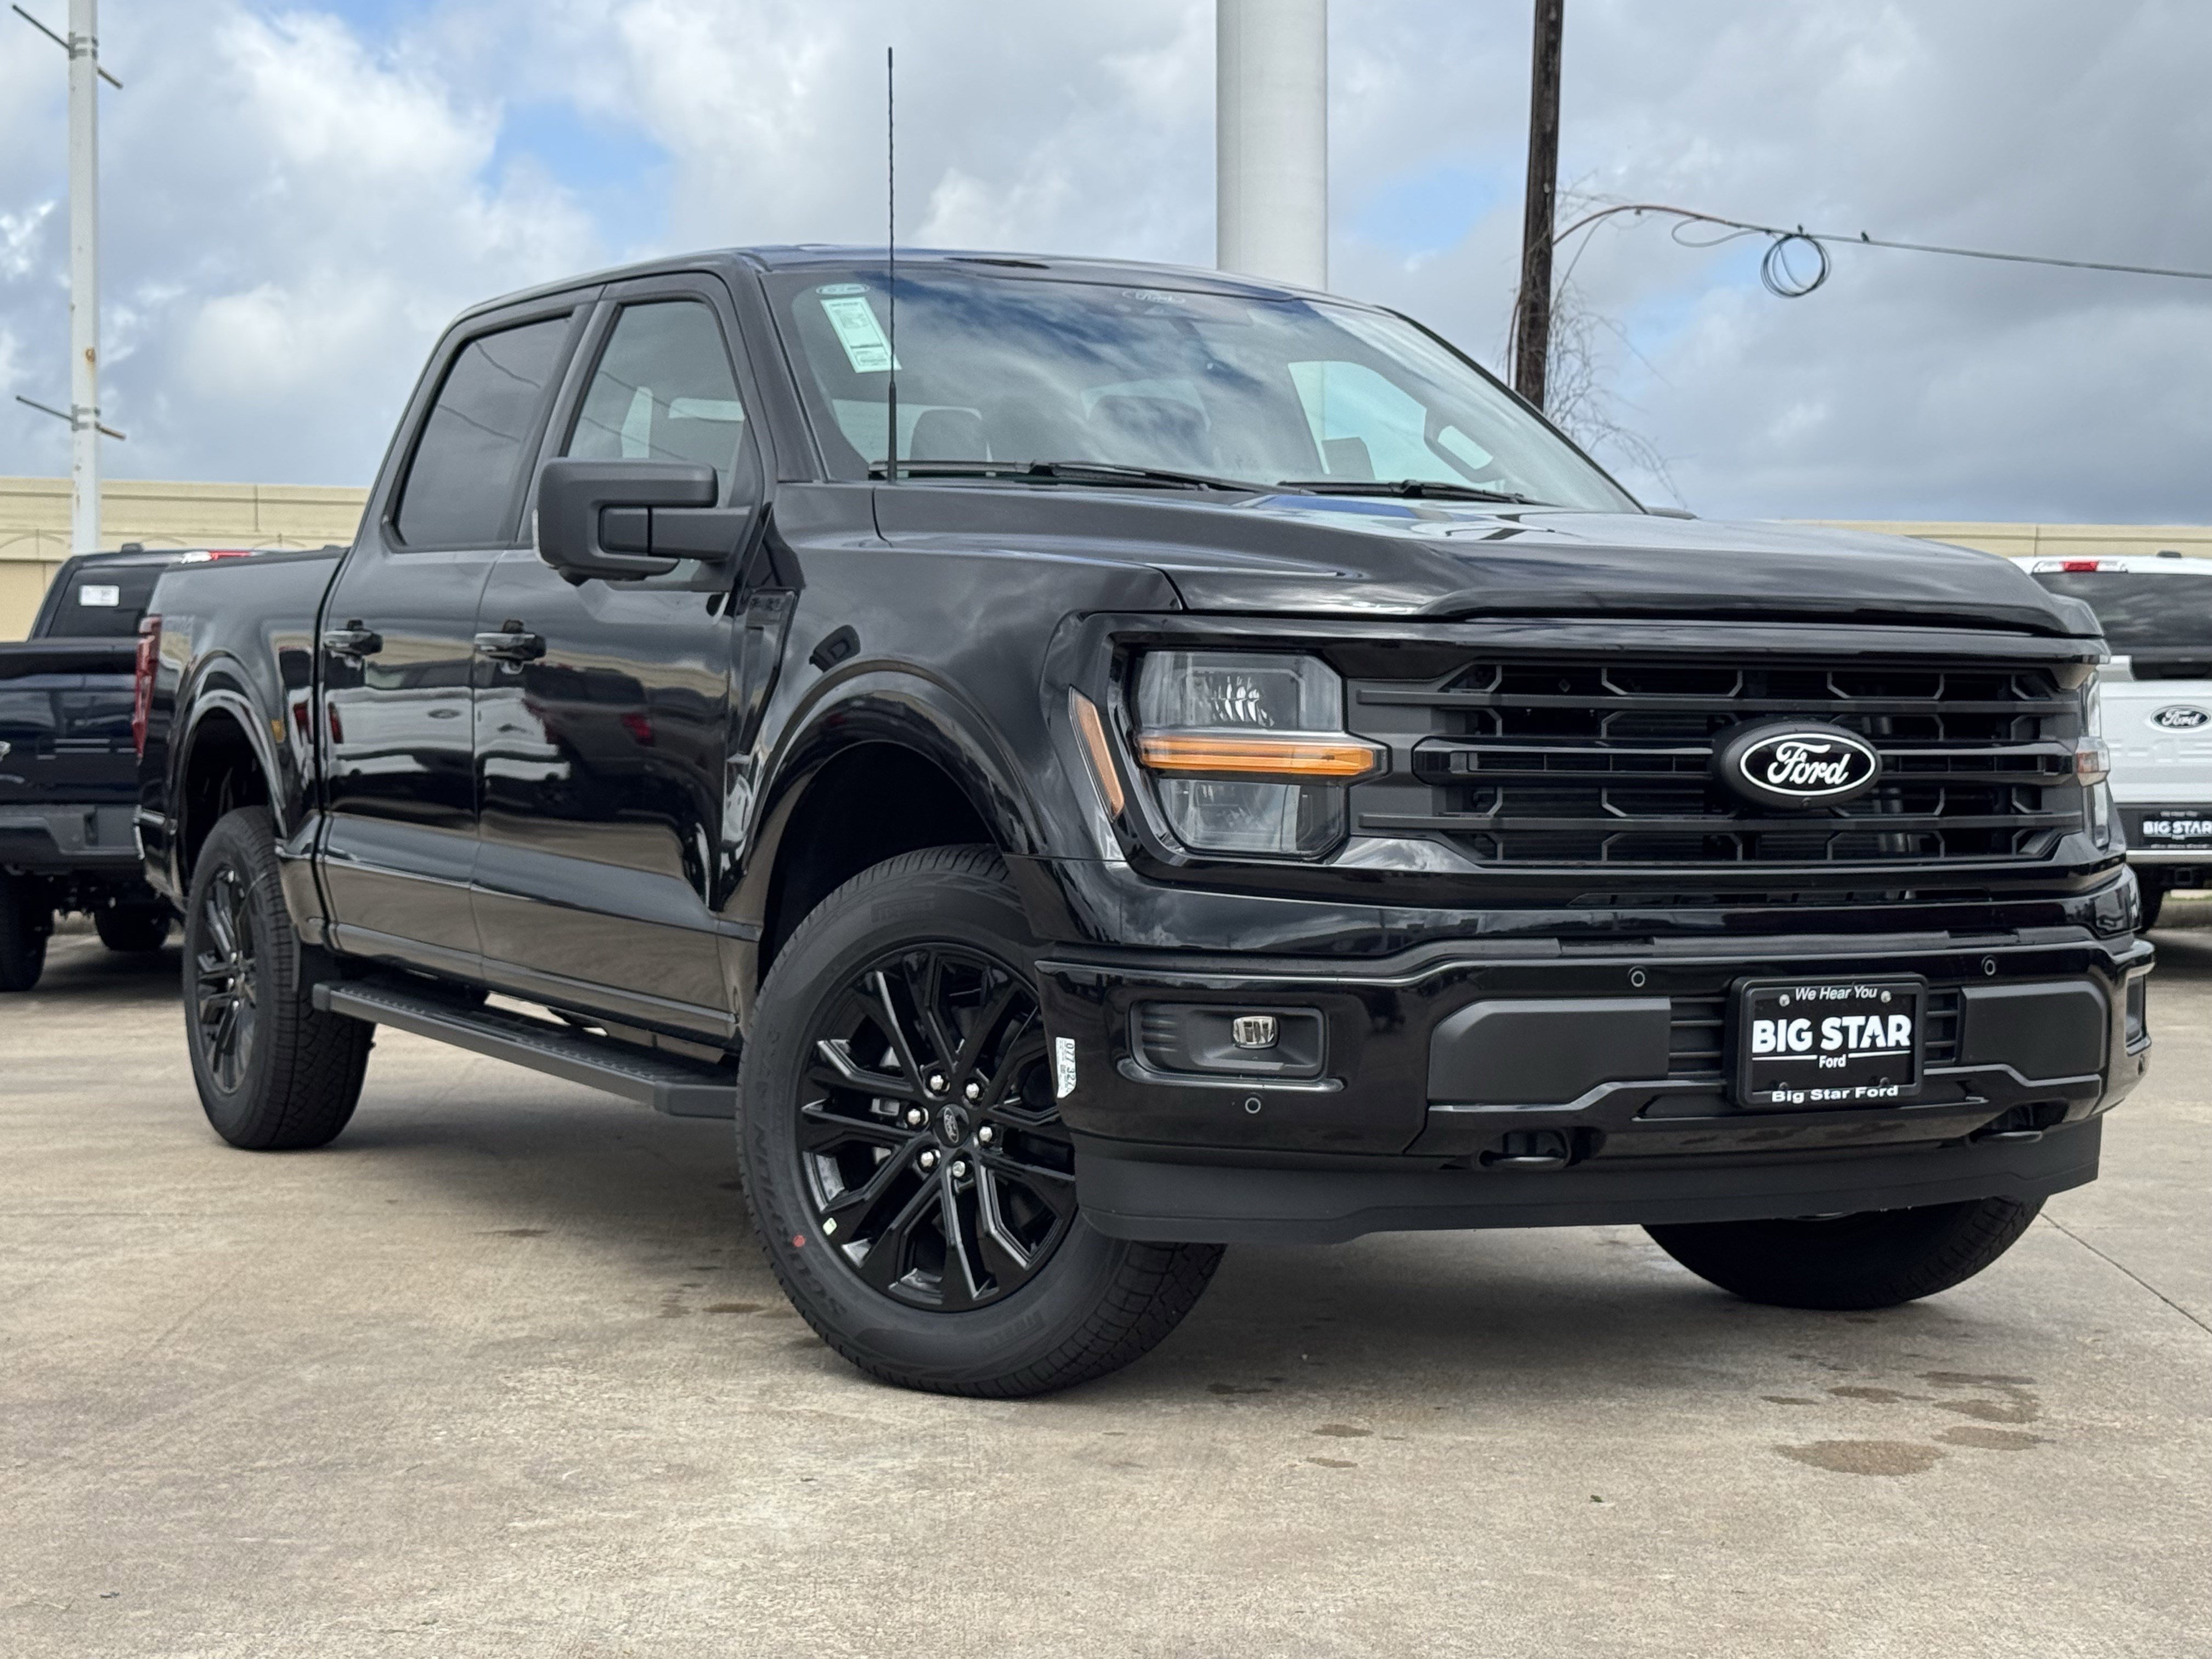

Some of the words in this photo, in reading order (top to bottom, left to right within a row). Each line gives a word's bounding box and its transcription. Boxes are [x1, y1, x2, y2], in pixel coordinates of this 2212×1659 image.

[2162, 709, 2200, 725] Ford
[1767, 741, 1851, 785] Ford
[2143, 820, 2171, 834] BIG
[2172, 820, 2212, 834] STAR
[1795, 987, 1816, 1001] We
[1819, 986, 1852, 1001] Hear
[1854, 985, 1878, 999] You
[1752, 1018, 1813, 1053] BIG
[1820, 1014, 1912, 1051] STAR
[1819, 1054, 1847, 1069] Ford
[1771, 1090, 1805, 1104] Big
[1810, 1089, 1850, 1101] Star
[1855, 1085, 1899, 1098] Ford
